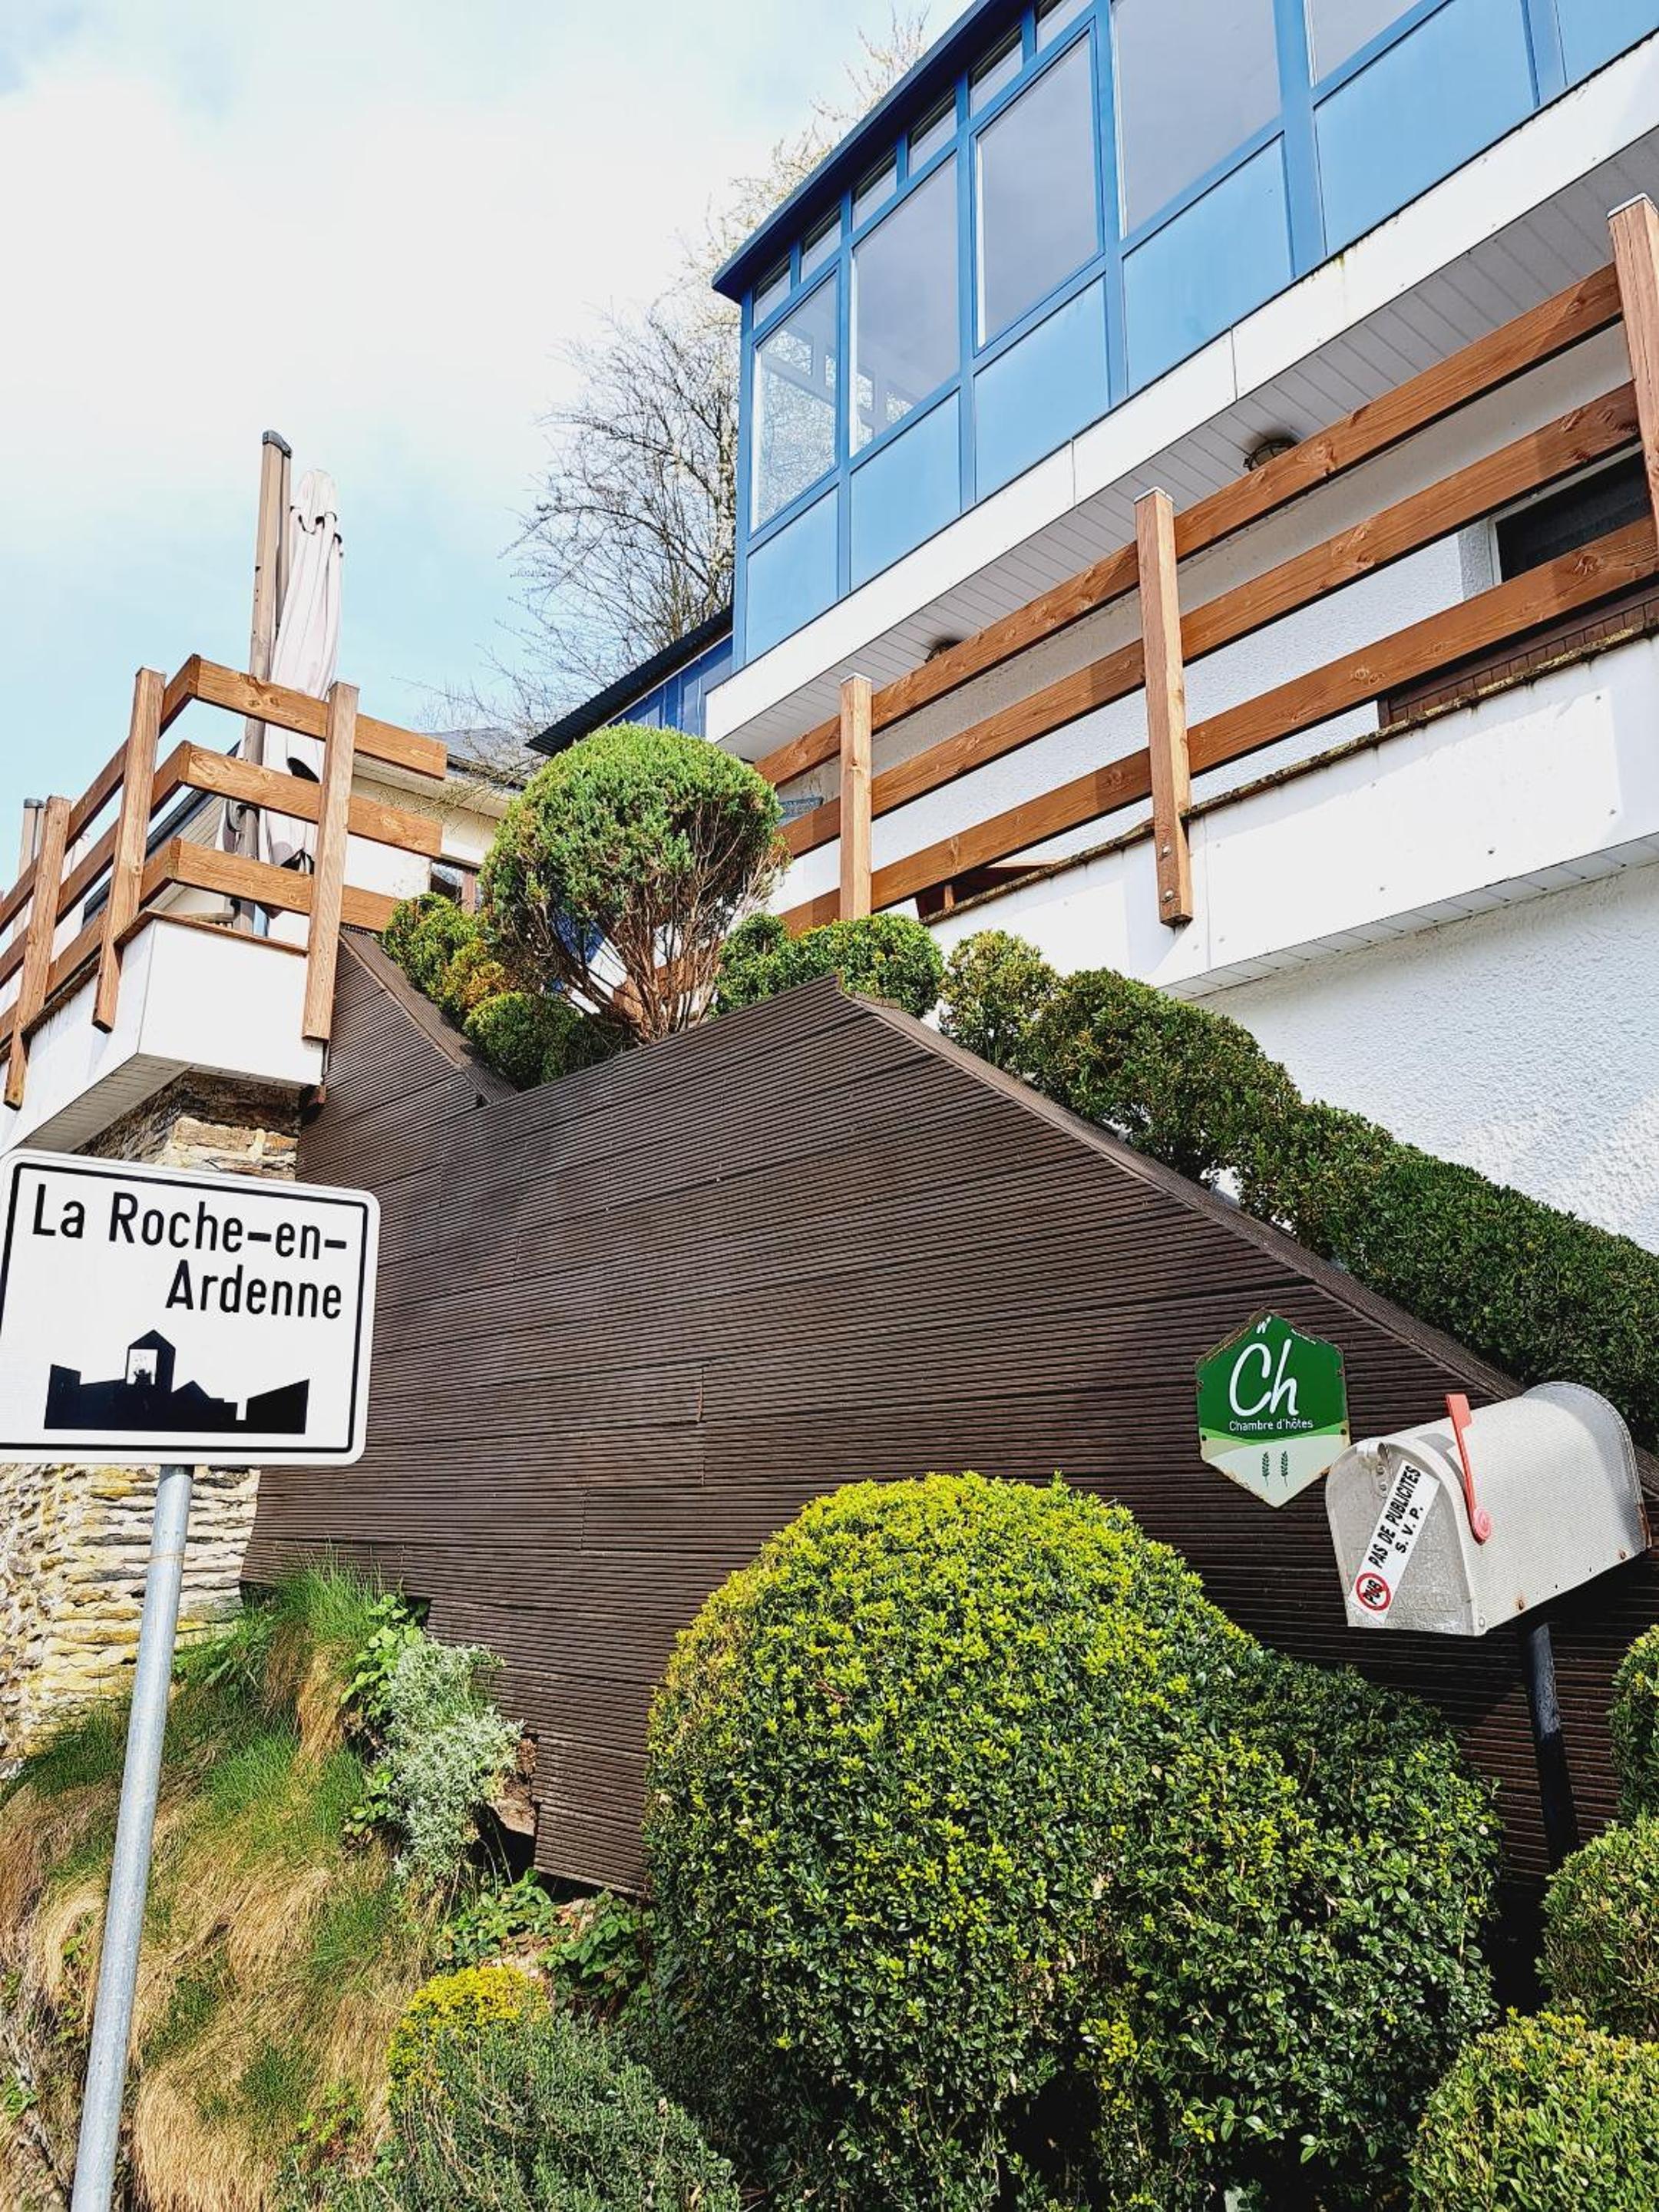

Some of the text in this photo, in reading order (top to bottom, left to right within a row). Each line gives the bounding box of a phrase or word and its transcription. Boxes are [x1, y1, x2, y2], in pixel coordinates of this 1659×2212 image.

[32, 1183, 347, 1260] La Roche-en-
[165, 1259, 342, 1319] Ardenne
[1229, 1338, 1299, 1417] Ch
[1229, 1417, 1314, 1432] Chambre d'hôtes
[1368, 1465, 1421, 1569] PAS DE PUBLICITES
[1363, 1579, 1383, 1605] PUB
